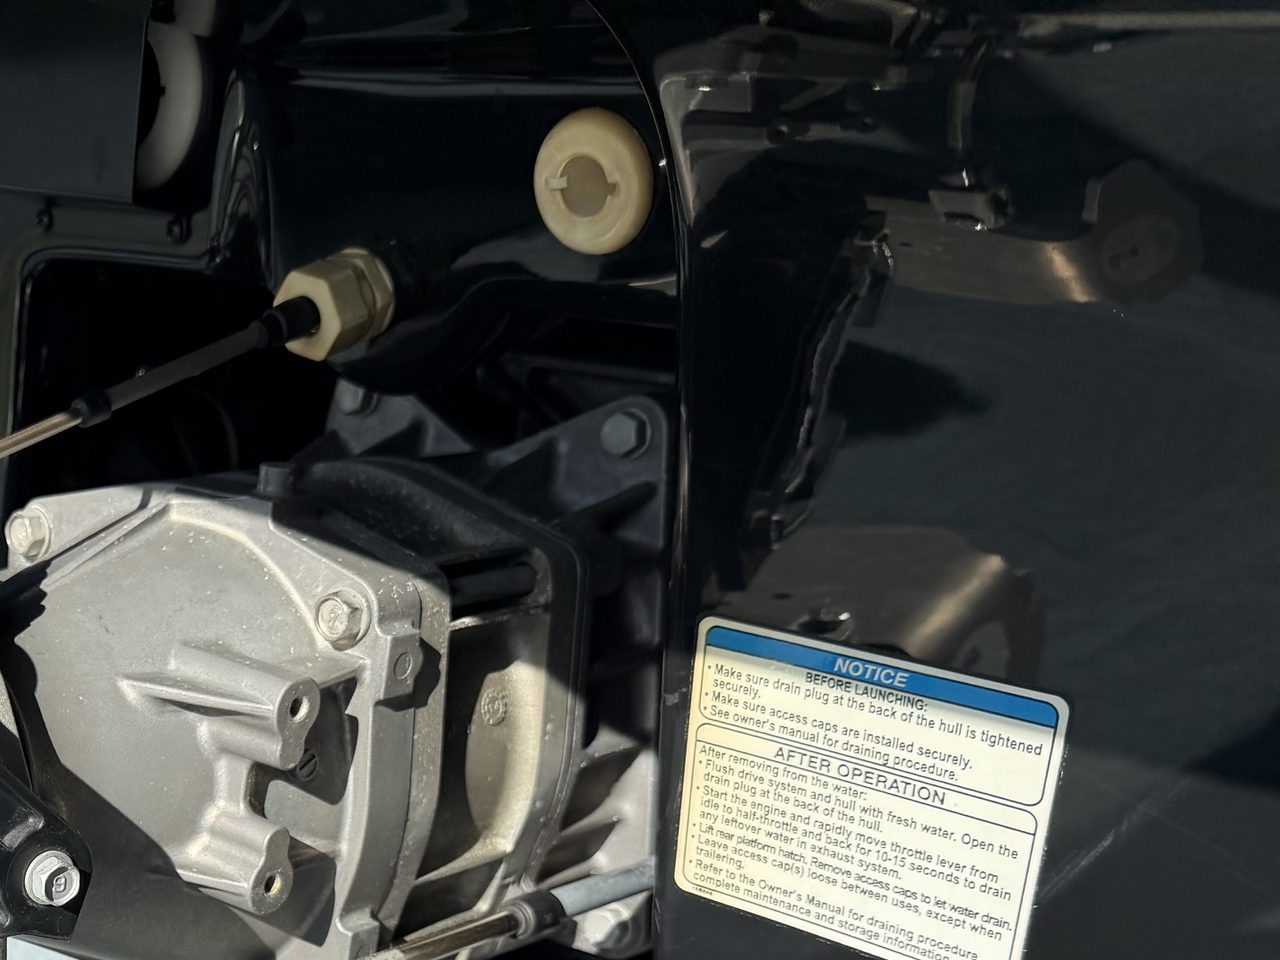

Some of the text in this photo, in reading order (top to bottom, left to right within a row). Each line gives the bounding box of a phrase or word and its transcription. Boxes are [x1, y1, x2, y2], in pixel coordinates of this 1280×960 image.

[712, 678, 761, 700] securely.
[804, 671, 929, 712] BEFORE LAUNCHING:
[833, 657, 909, 687] NOTICE
[709, 704, 958, 781] See owner's manual for draining procedure.
[711, 690, 972, 770] Make sure access caps are installed securely.
[714, 663, 1043, 756] Make sure drain plug at the back of the hull is tightened
[699, 744, 867, 801] After removing from the water:
[703, 771, 883, 833] drain plug at the back of the hull.
[705, 758, 1018, 859] Flush drive system and hull with fresh water. Open the
[773, 746, 946, 805] AFTER OPERATION
[696, 845, 744, 870] trailering.
[699, 810, 902, 880] any leftover water in exhaust system.
[700, 796, 1011, 901] idle to half-throttle and back for 10-15 seconds to drain
[702, 784, 998, 884] Start the engine and rapidly move throttle lever from
[693, 872, 740, 893] complete
[743, 888, 811, 917] maintenance
[814, 911, 835, 925] and
[838, 919, 880, 940] storage
[695, 858, 723, 875] Refer
[725, 869, 736, 880] to
[739, 873, 755, 886] the
[758, 879, 802, 902] Owner's
[805, 894, 845, 916] Manual
[848, 908, 864, 921] for
[866, 916, 914, 942] draining
[698, 833, 1002, 941] Leave access cap(s) loose between uses, except when
[699, 821, 1012, 931] Lift rear platform hatch. Remove access caps to let water drain.
